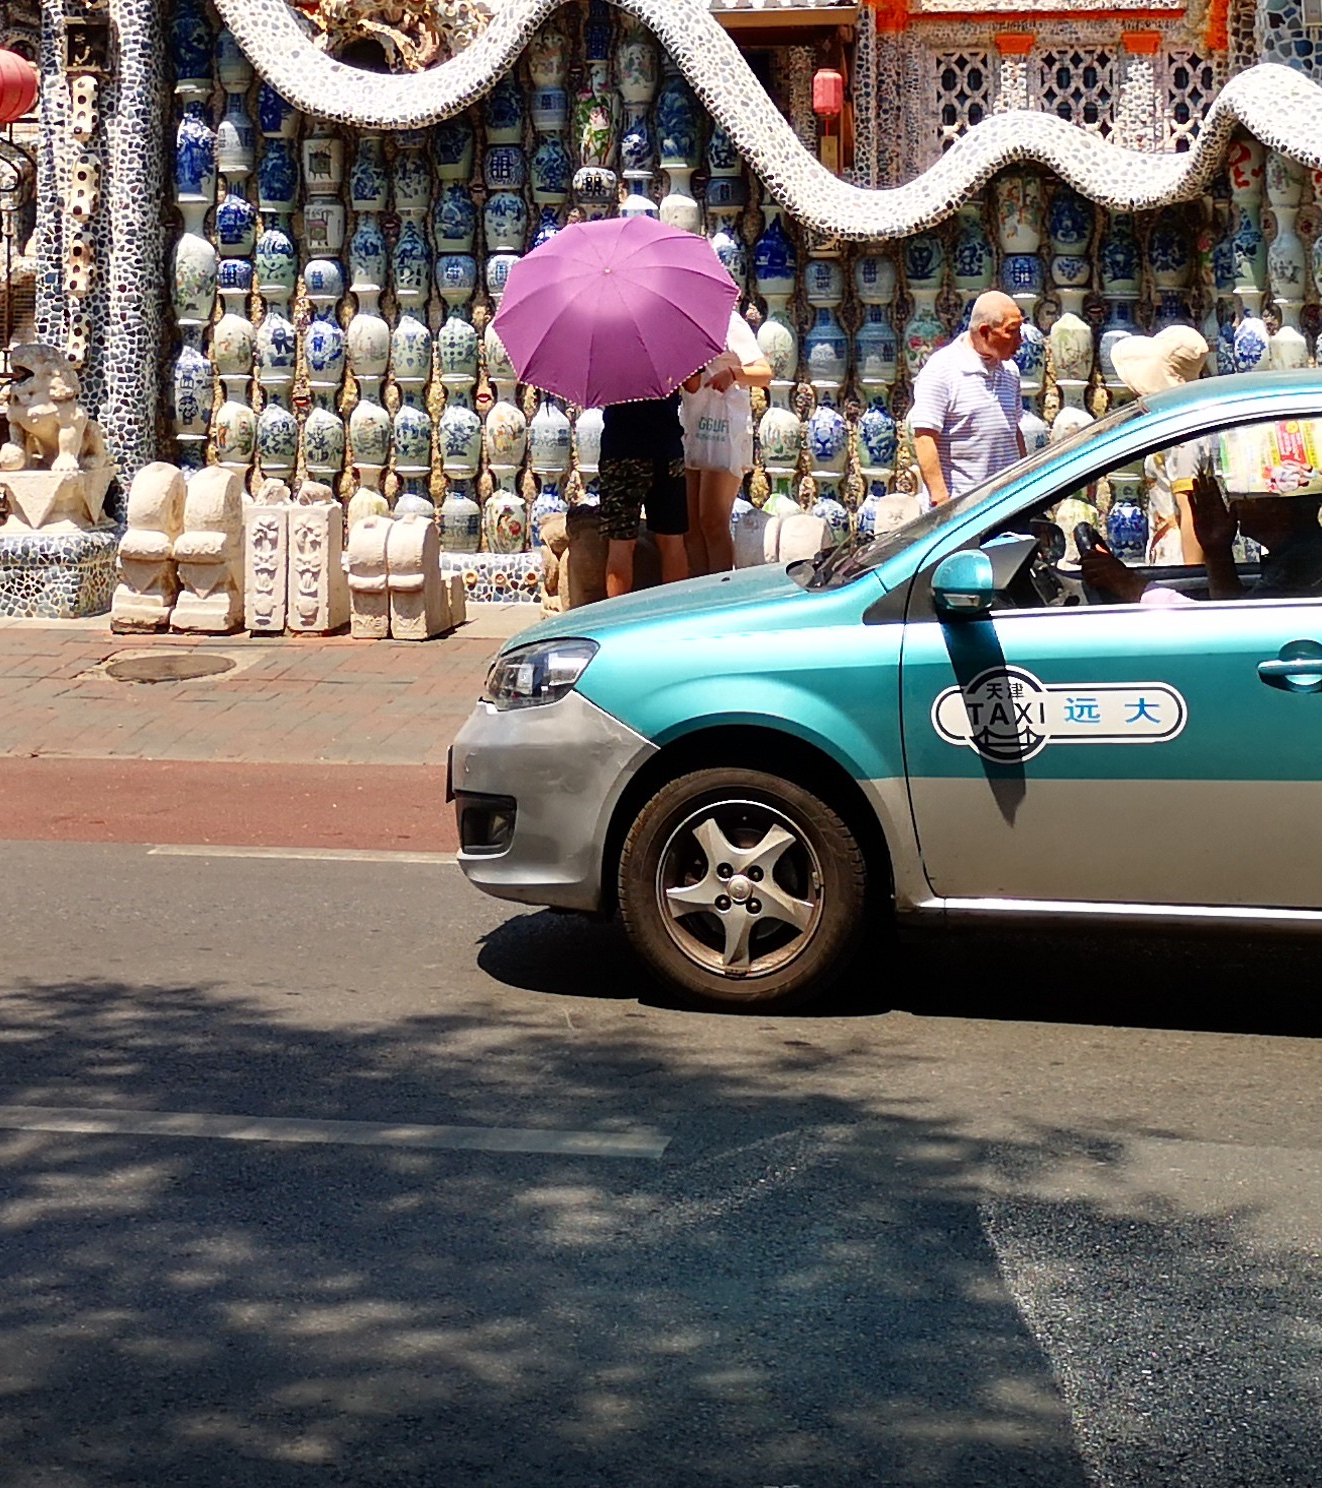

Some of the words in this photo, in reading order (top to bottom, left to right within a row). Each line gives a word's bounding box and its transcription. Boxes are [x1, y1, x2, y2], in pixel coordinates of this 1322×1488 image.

[985, 682, 1024, 700] 天津
[967, 701, 1046, 726] TAXI
[1063, 697, 1162, 725] 远大
